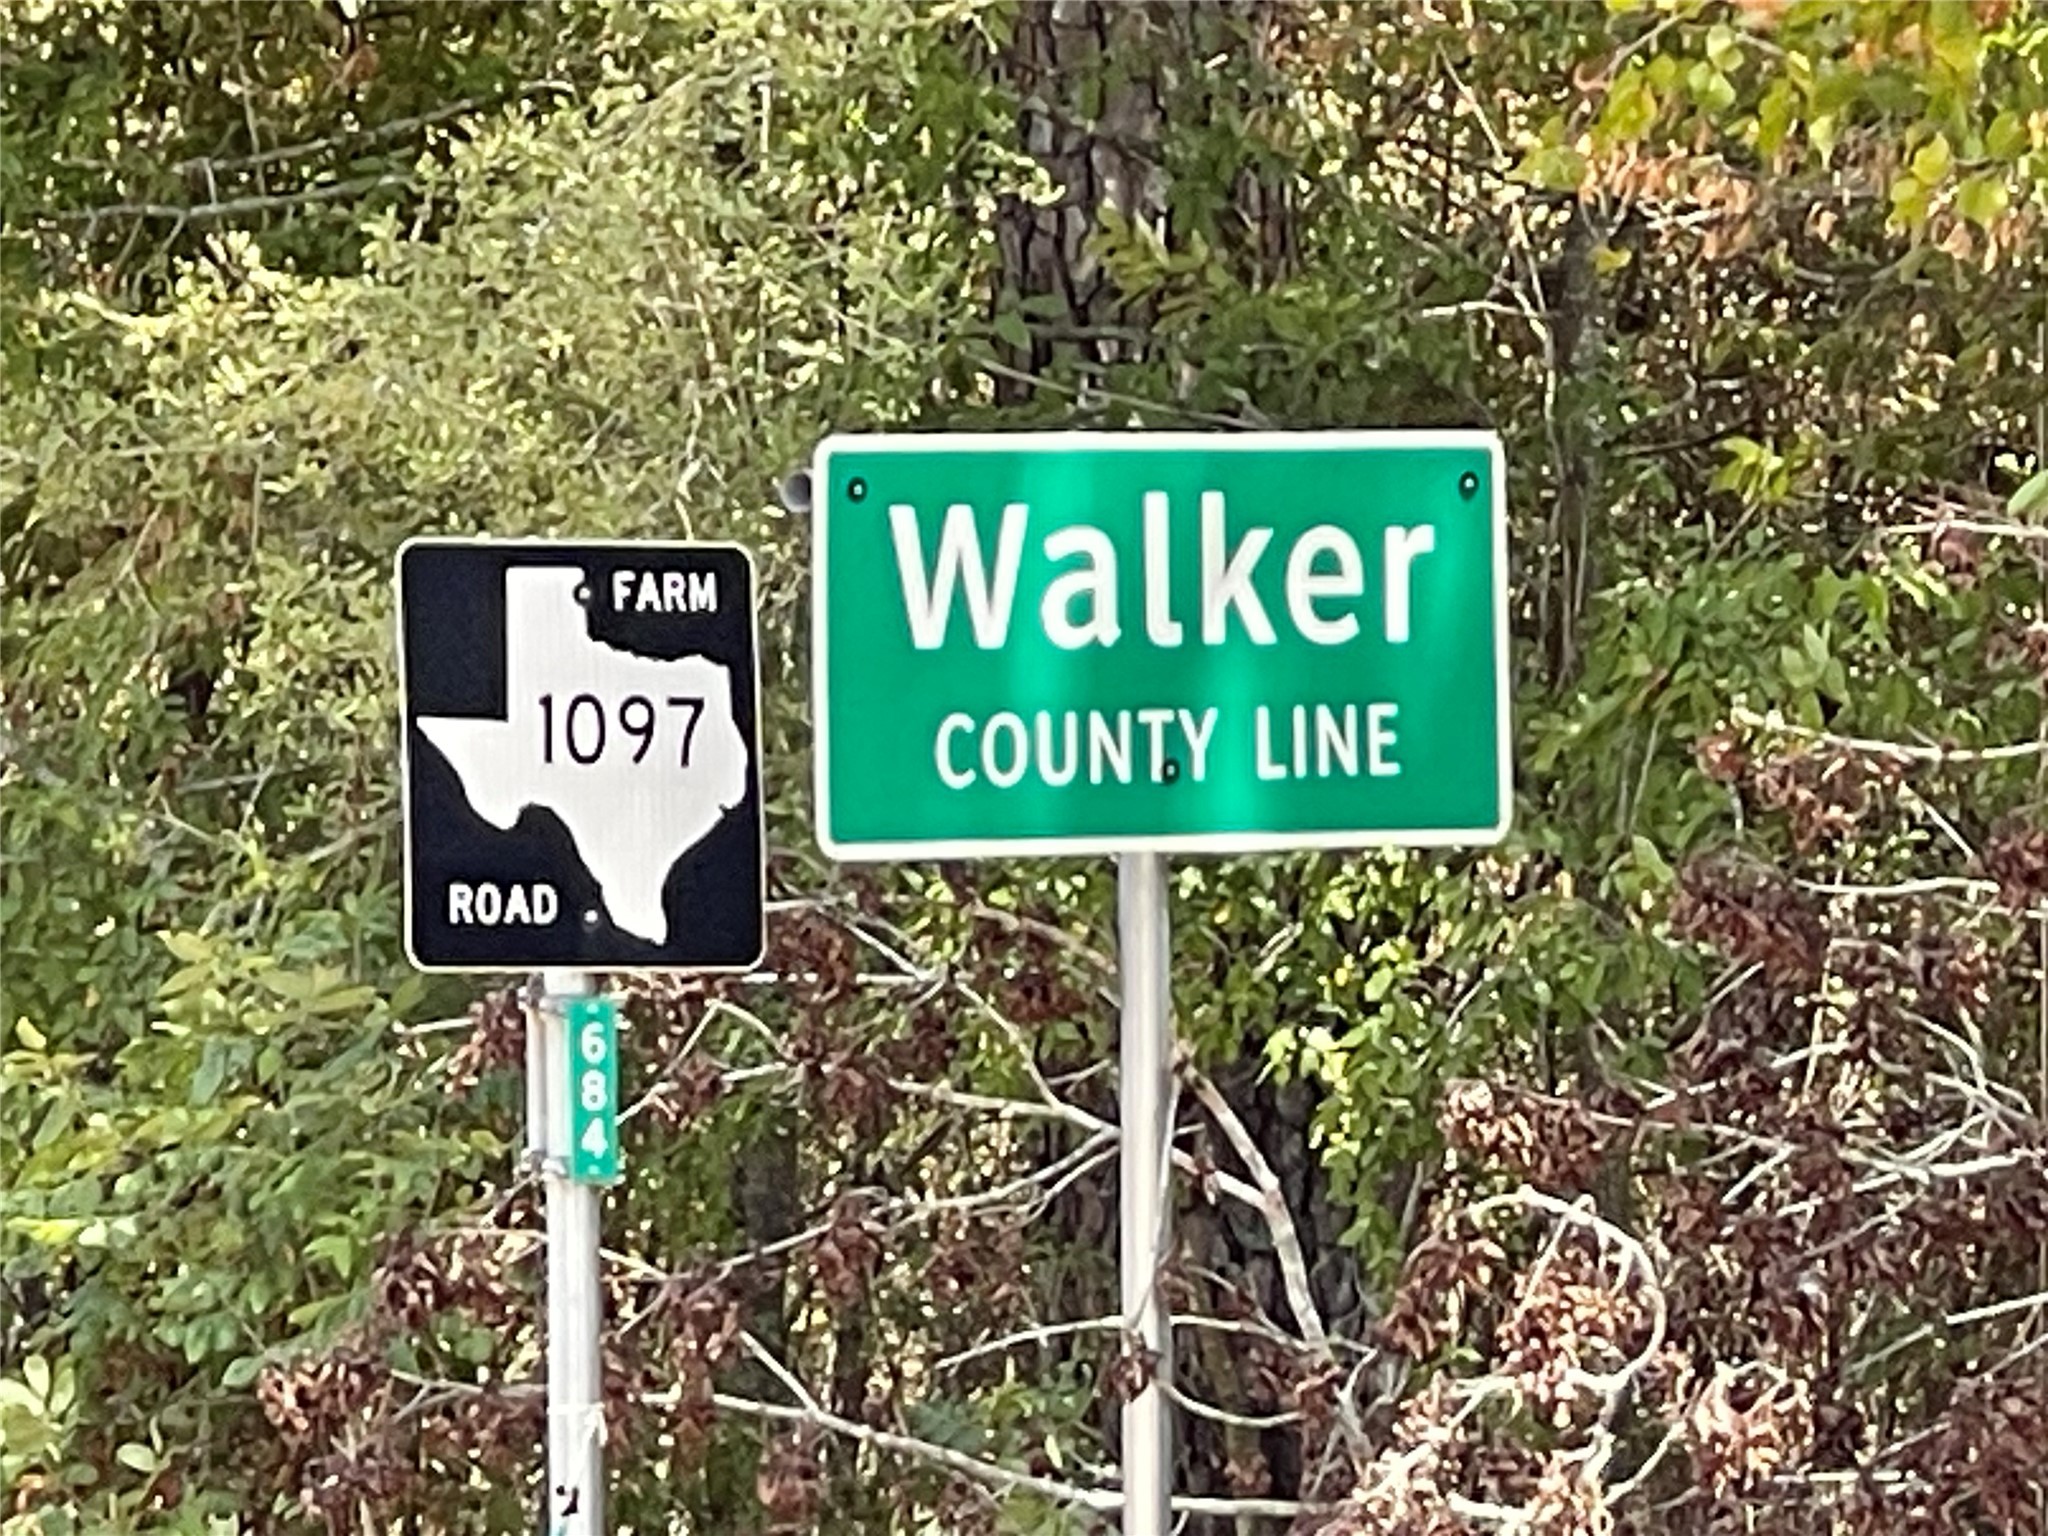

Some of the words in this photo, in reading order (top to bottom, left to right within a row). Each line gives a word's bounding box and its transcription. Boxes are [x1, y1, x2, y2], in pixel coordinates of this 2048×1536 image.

[611, 570, 718, 612] FARM
[888, 490, 1435, 650] Walker
[538, 693, 705, 768] 1097
[934, 706, 1219, 790] COUNTY
[1255, 703, 1401, 780] LINE
[448, 883, 558, 925] ROAD
[580, 1021, 609, 1160] 684
